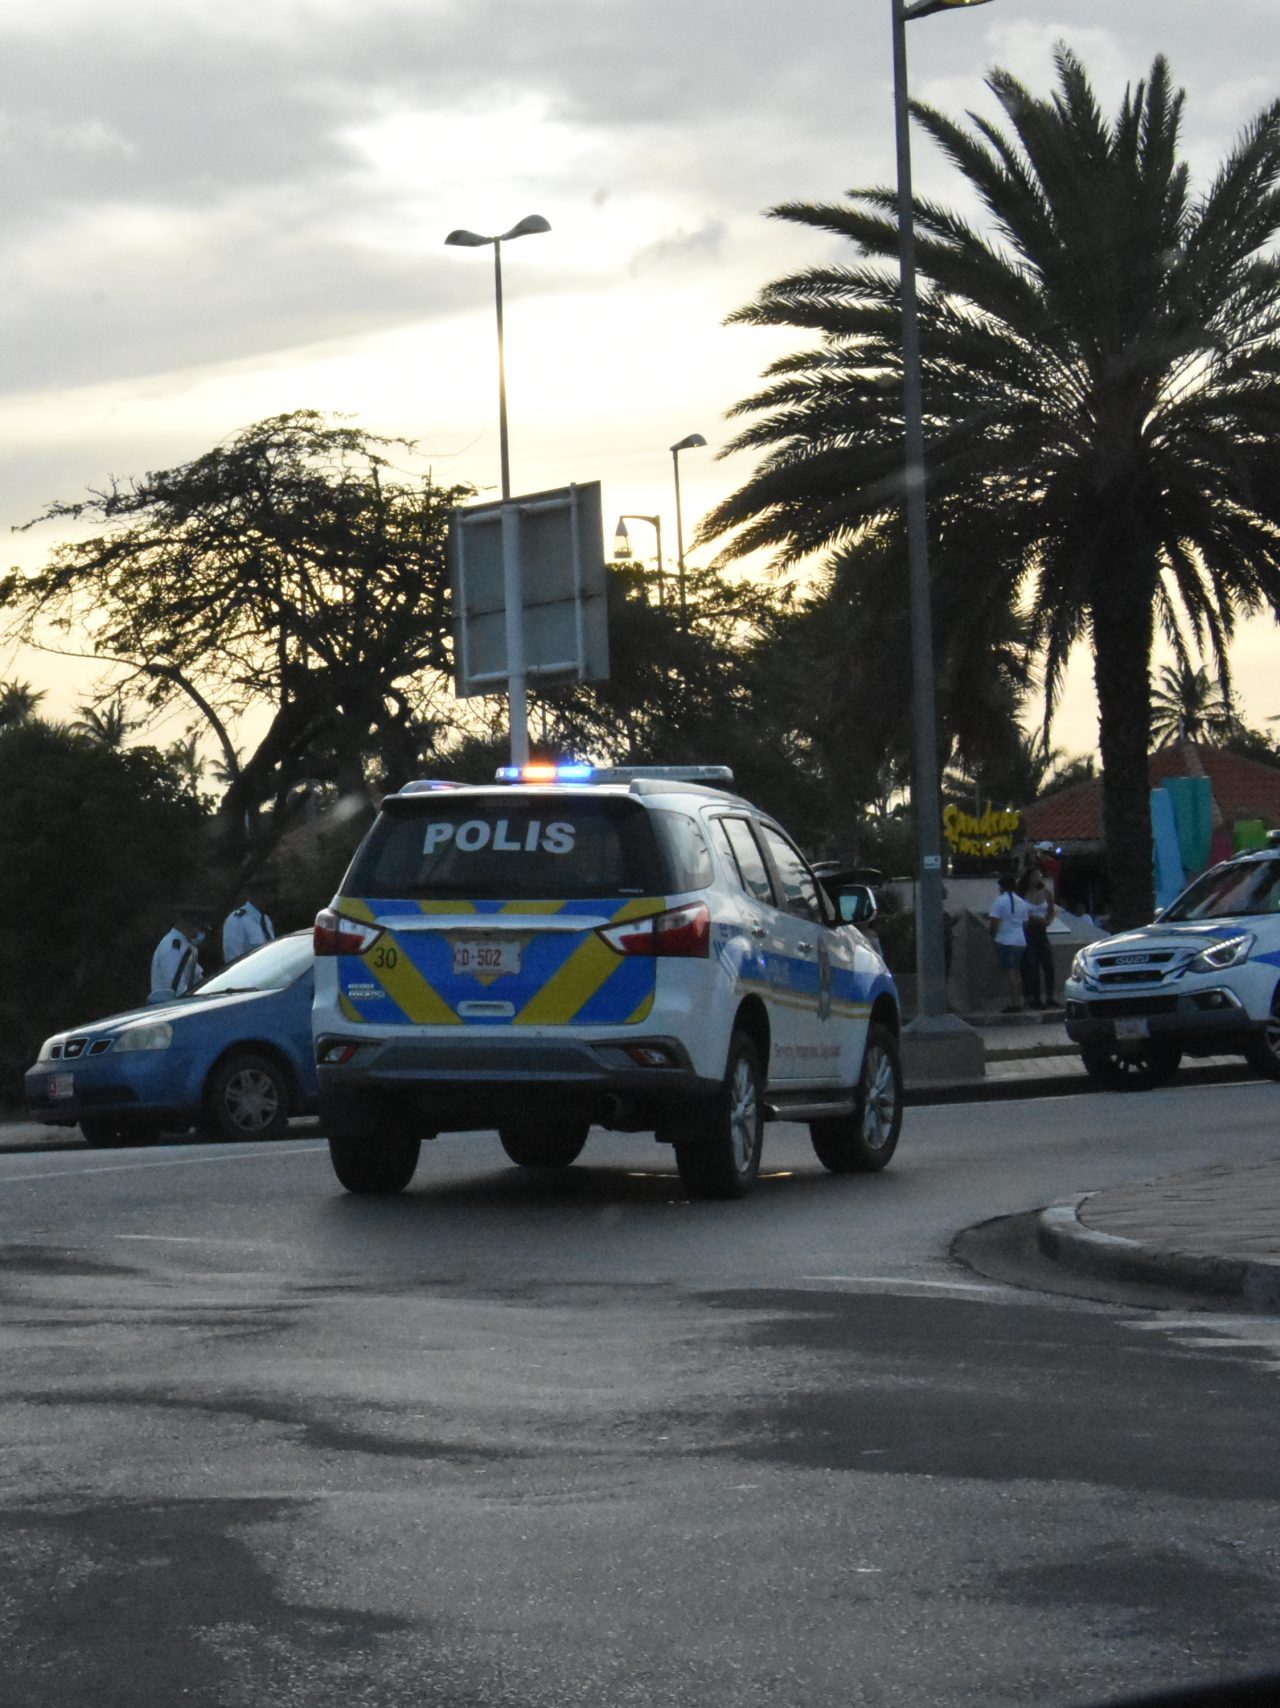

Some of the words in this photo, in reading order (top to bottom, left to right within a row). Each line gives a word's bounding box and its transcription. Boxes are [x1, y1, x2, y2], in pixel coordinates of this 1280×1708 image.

[423, 820, 576, 854] POLIS
[374, 947, 398, 969] 30
[1115, 955, 1149, 965] ISUZU
